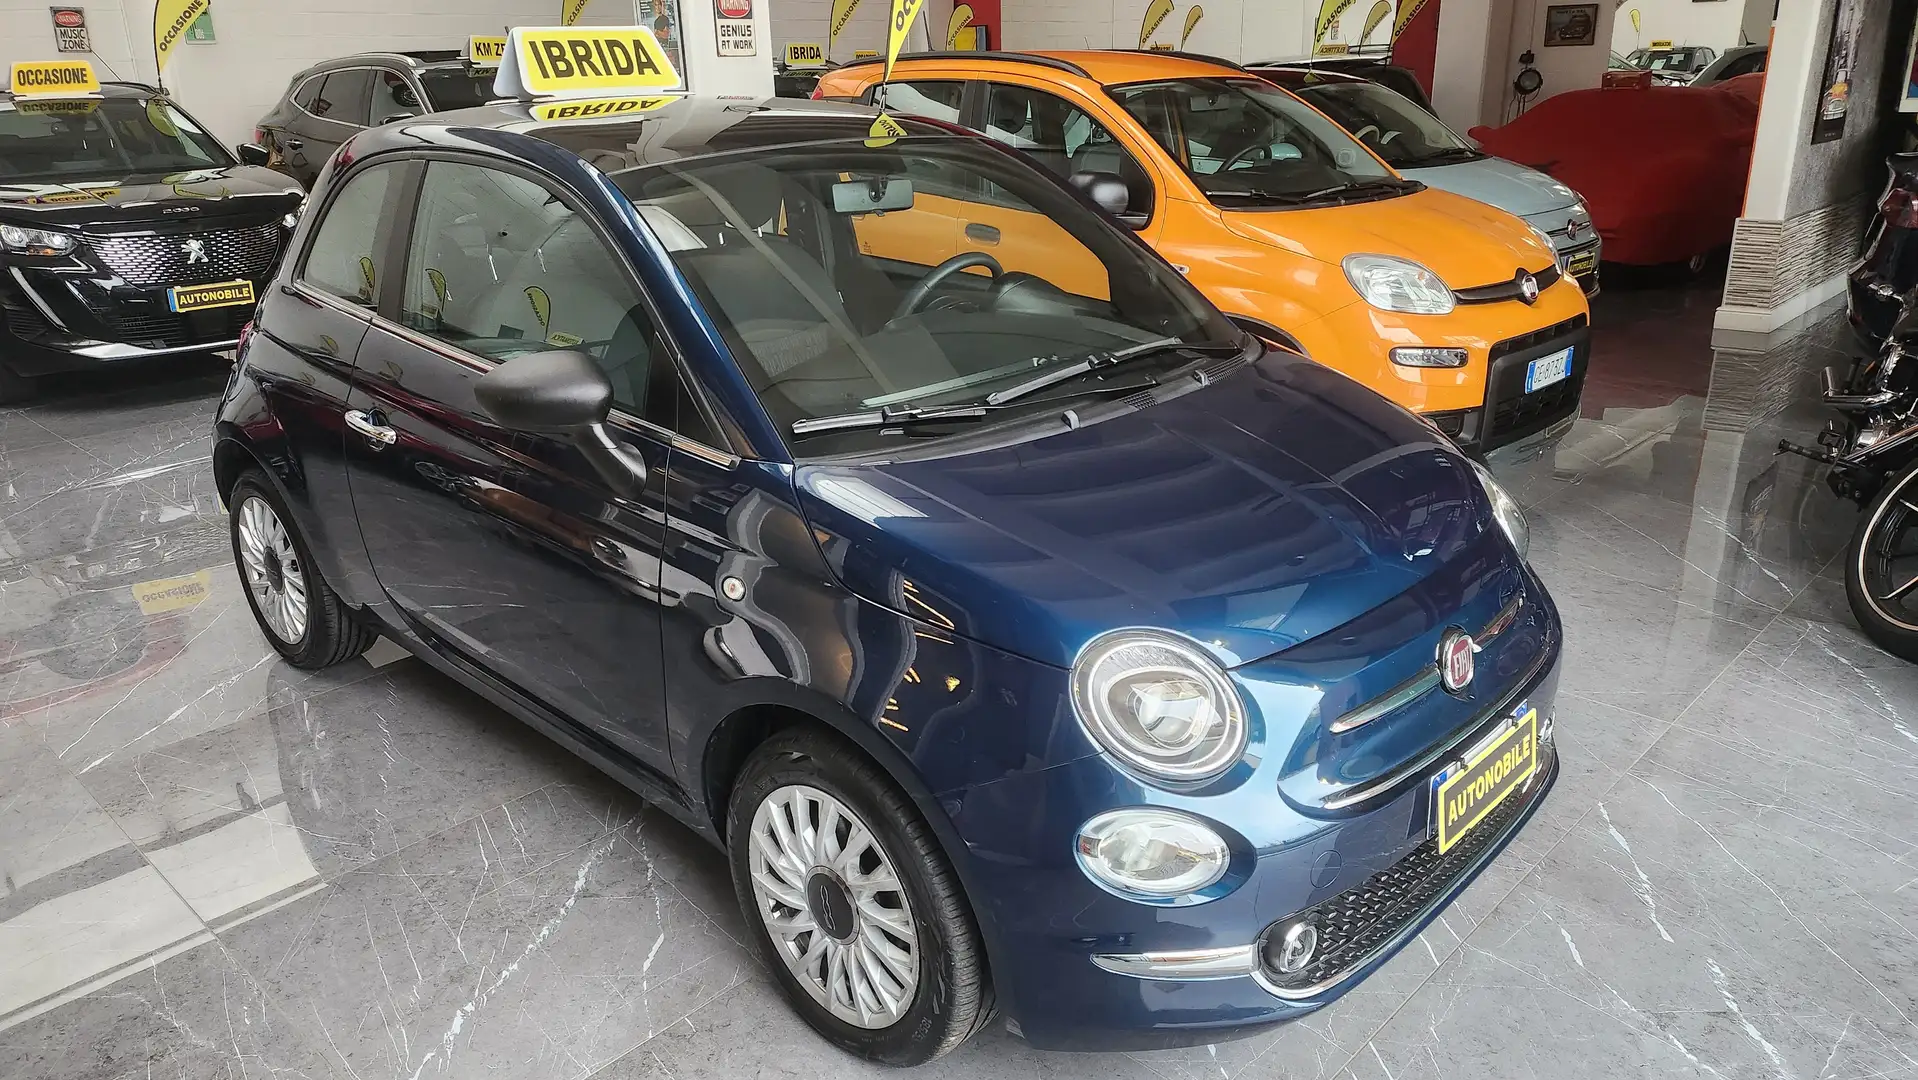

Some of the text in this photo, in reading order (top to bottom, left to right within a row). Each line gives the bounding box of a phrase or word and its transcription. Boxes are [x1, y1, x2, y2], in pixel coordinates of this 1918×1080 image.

[567, 0, 587, 26] CCASIO
[60, 28, 86, 39] MUSIC
[159, 0, 203, 52] OCCASIONE
[720, 24, 752, 37] GENIUS
[948, 15, 971, 46] OCCASIONE
[1142, 7, 1171, 44] OCCASIONE
[62, 39, 86, 50] ZONE
[475, 42, 493, 57] KM
[721, 39, 754, 50] AT WORK
[790, 46, 822, 60] IBRIDA
[528, 39, 662, 79] IBRIDA
[17, 67, 89, 87] OCCASIONE
[180, 287, 251, 305] AUTONOBILE
[1453, 645, 1471, 680] FIAT
[1448, 733, 1531, 827] AUTONOBILE
